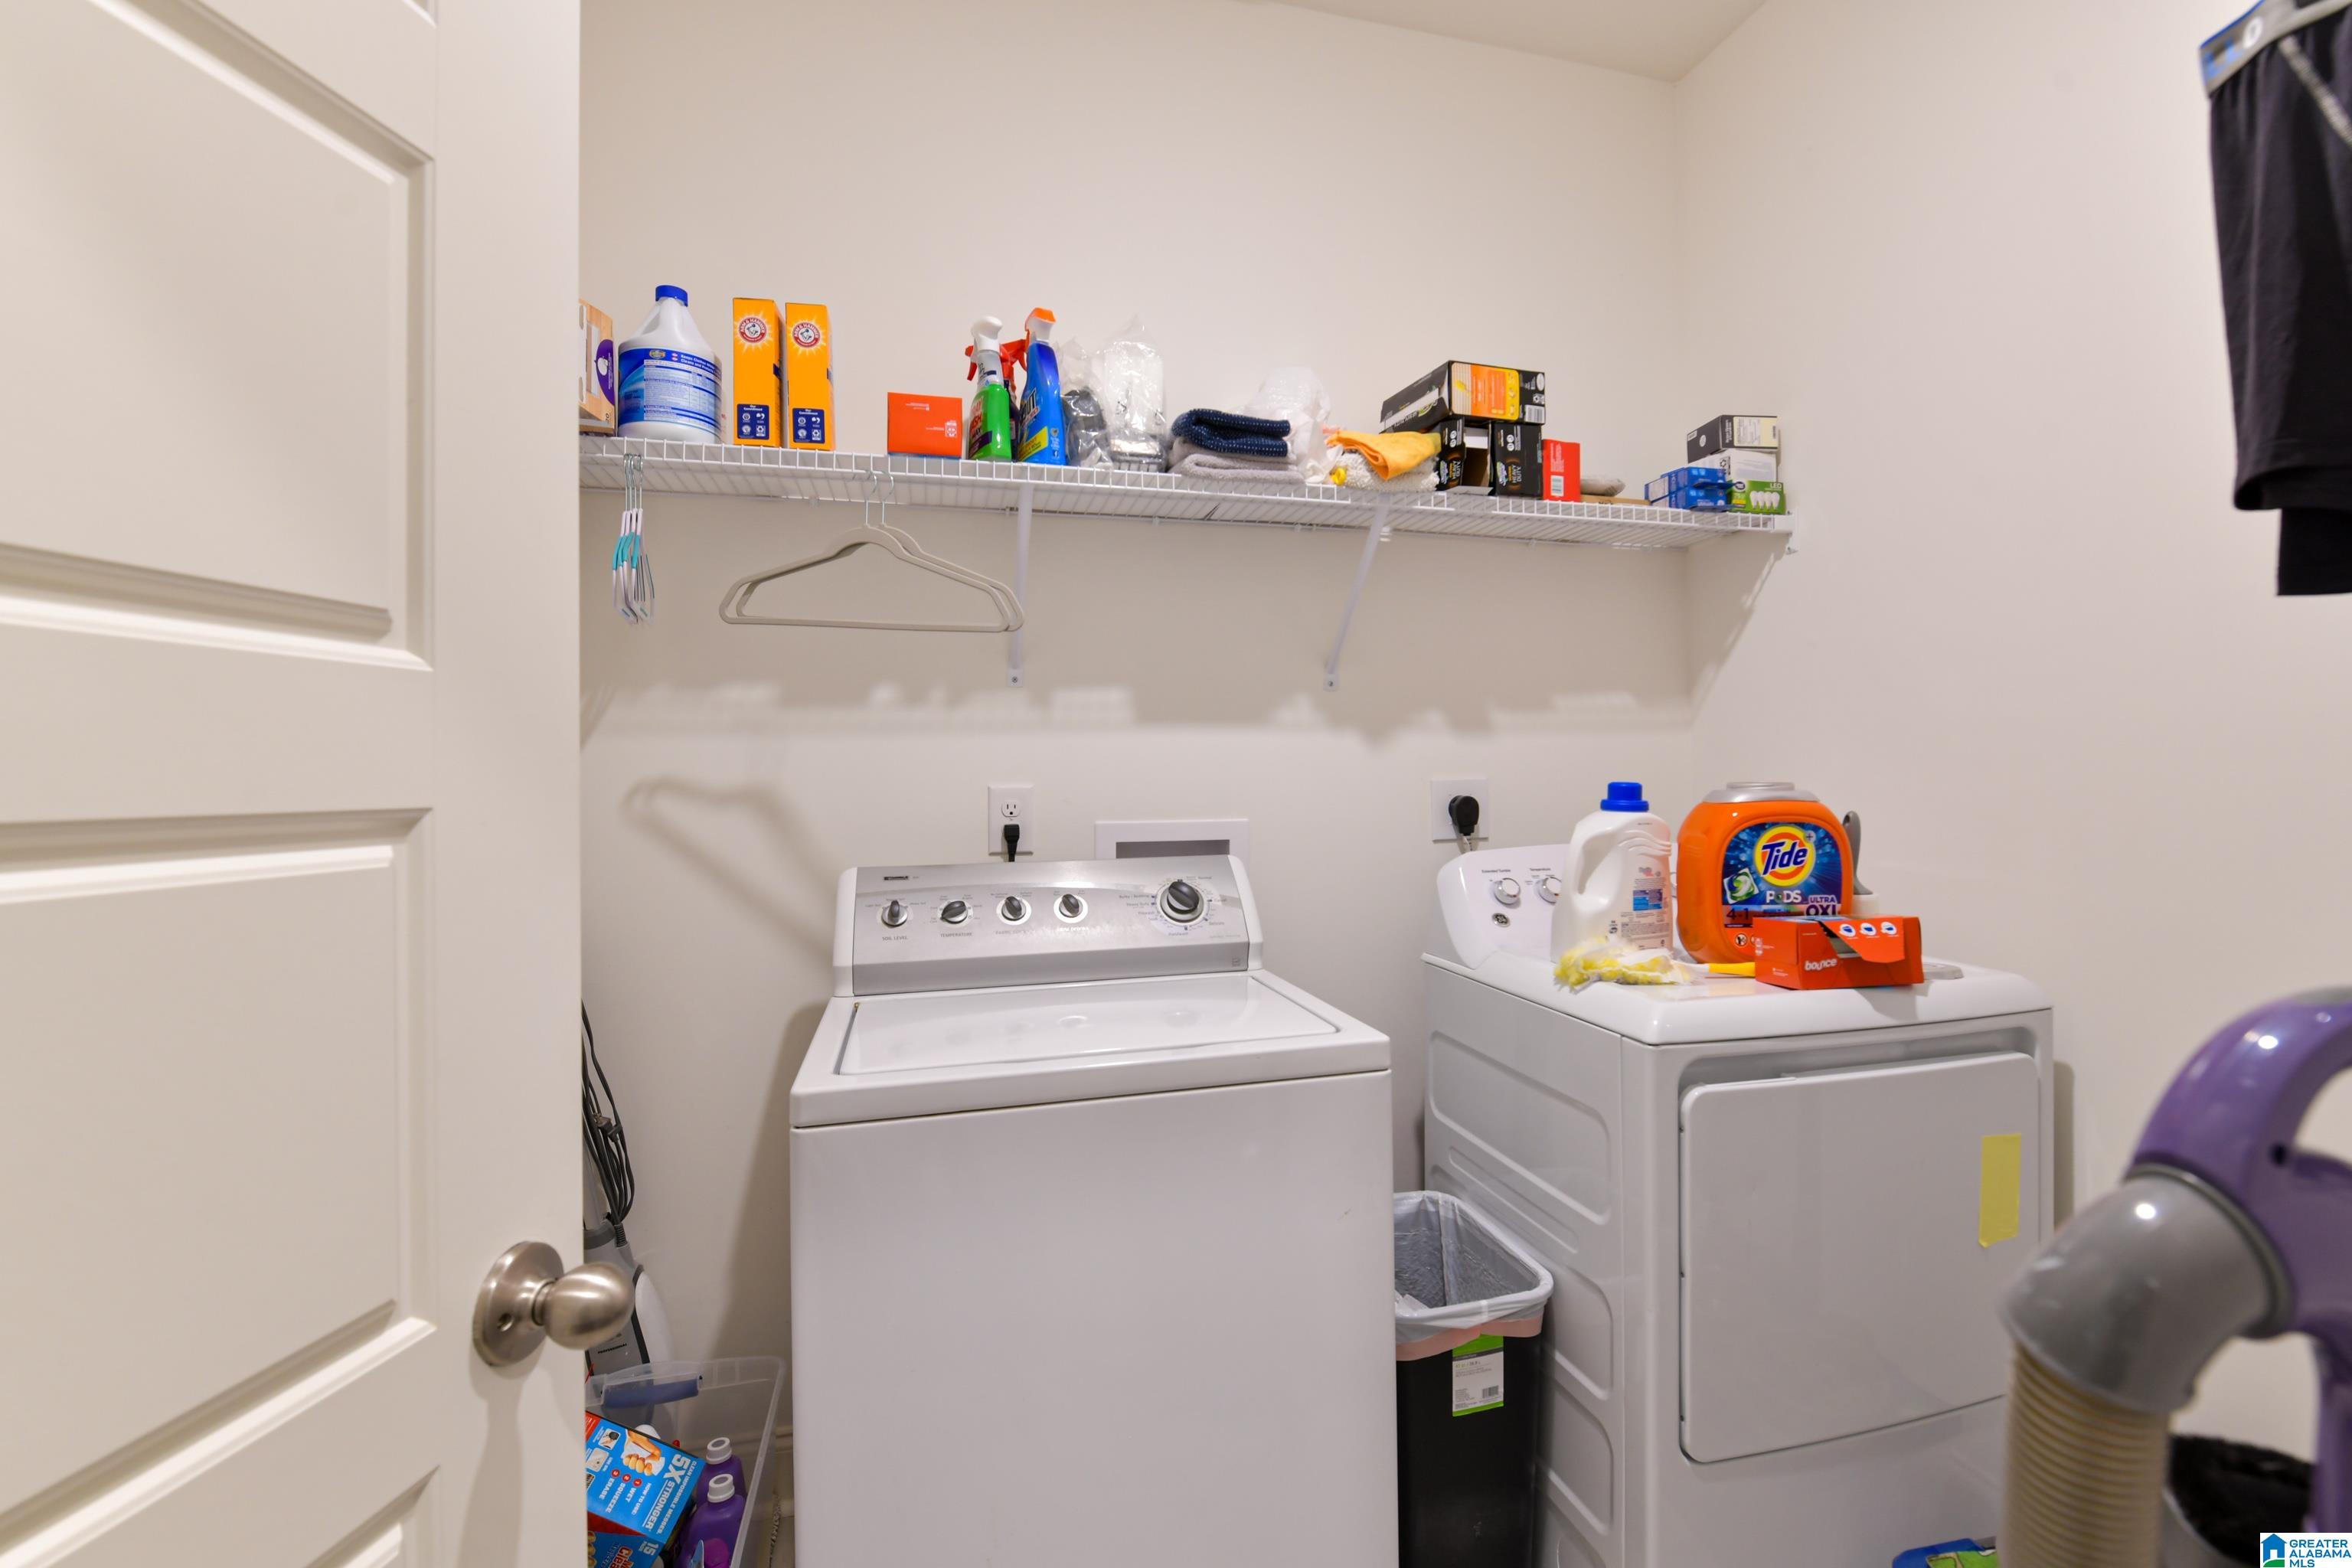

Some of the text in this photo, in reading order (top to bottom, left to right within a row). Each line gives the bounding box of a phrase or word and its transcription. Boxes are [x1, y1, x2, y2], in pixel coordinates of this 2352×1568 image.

[1761, 840, 1808, 877] Tide
[1806, 905, 1836, 916] OXI
[1805, 958, 1837, 970] bounce
[599, 1478, 614, 1500] ERASE
[605, 1483, 626, 1513] SQUEEZE
[625, 1487, 637, 1503] WET
[645, 1454, 691, 1529] 5X STRONGER
[644, 1543, 658, 1555] 15
